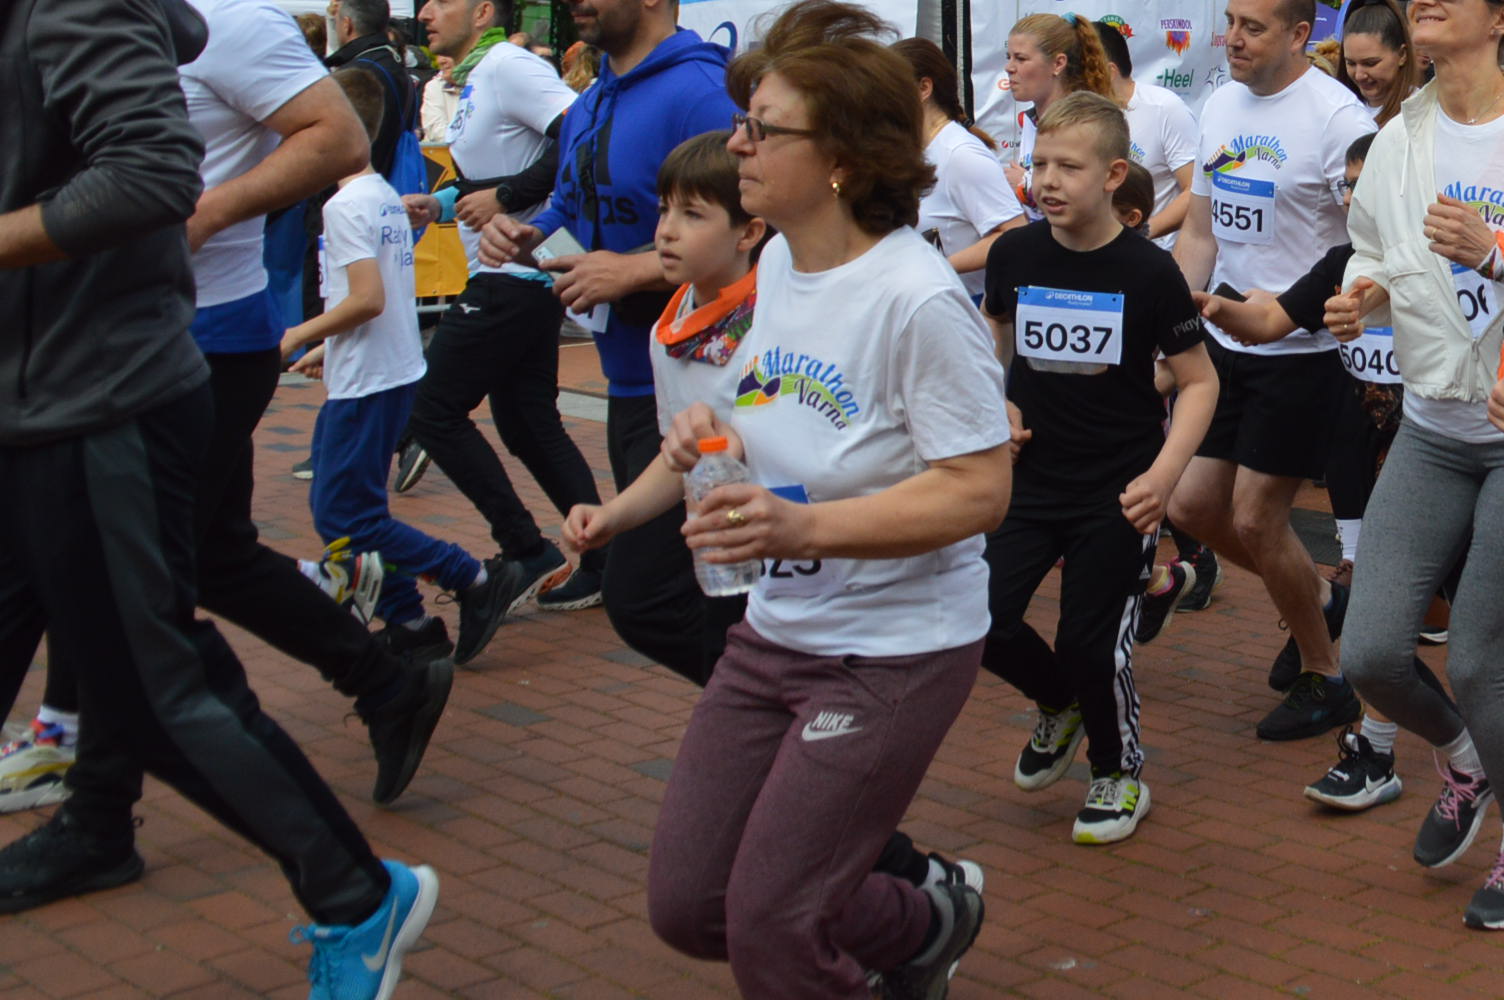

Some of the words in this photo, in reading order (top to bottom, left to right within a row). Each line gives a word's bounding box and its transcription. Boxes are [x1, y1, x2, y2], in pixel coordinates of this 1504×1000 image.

[1230, 135, 1288, 162] Marathon
[1212, 199, 1263, 233] 4551
[1024, 320, 1113, 355] 5037
[762, 345, 859, 418] Marathon
[794, 378, 847, 431] Varna
[811, 710, 855, 731] NIKE
